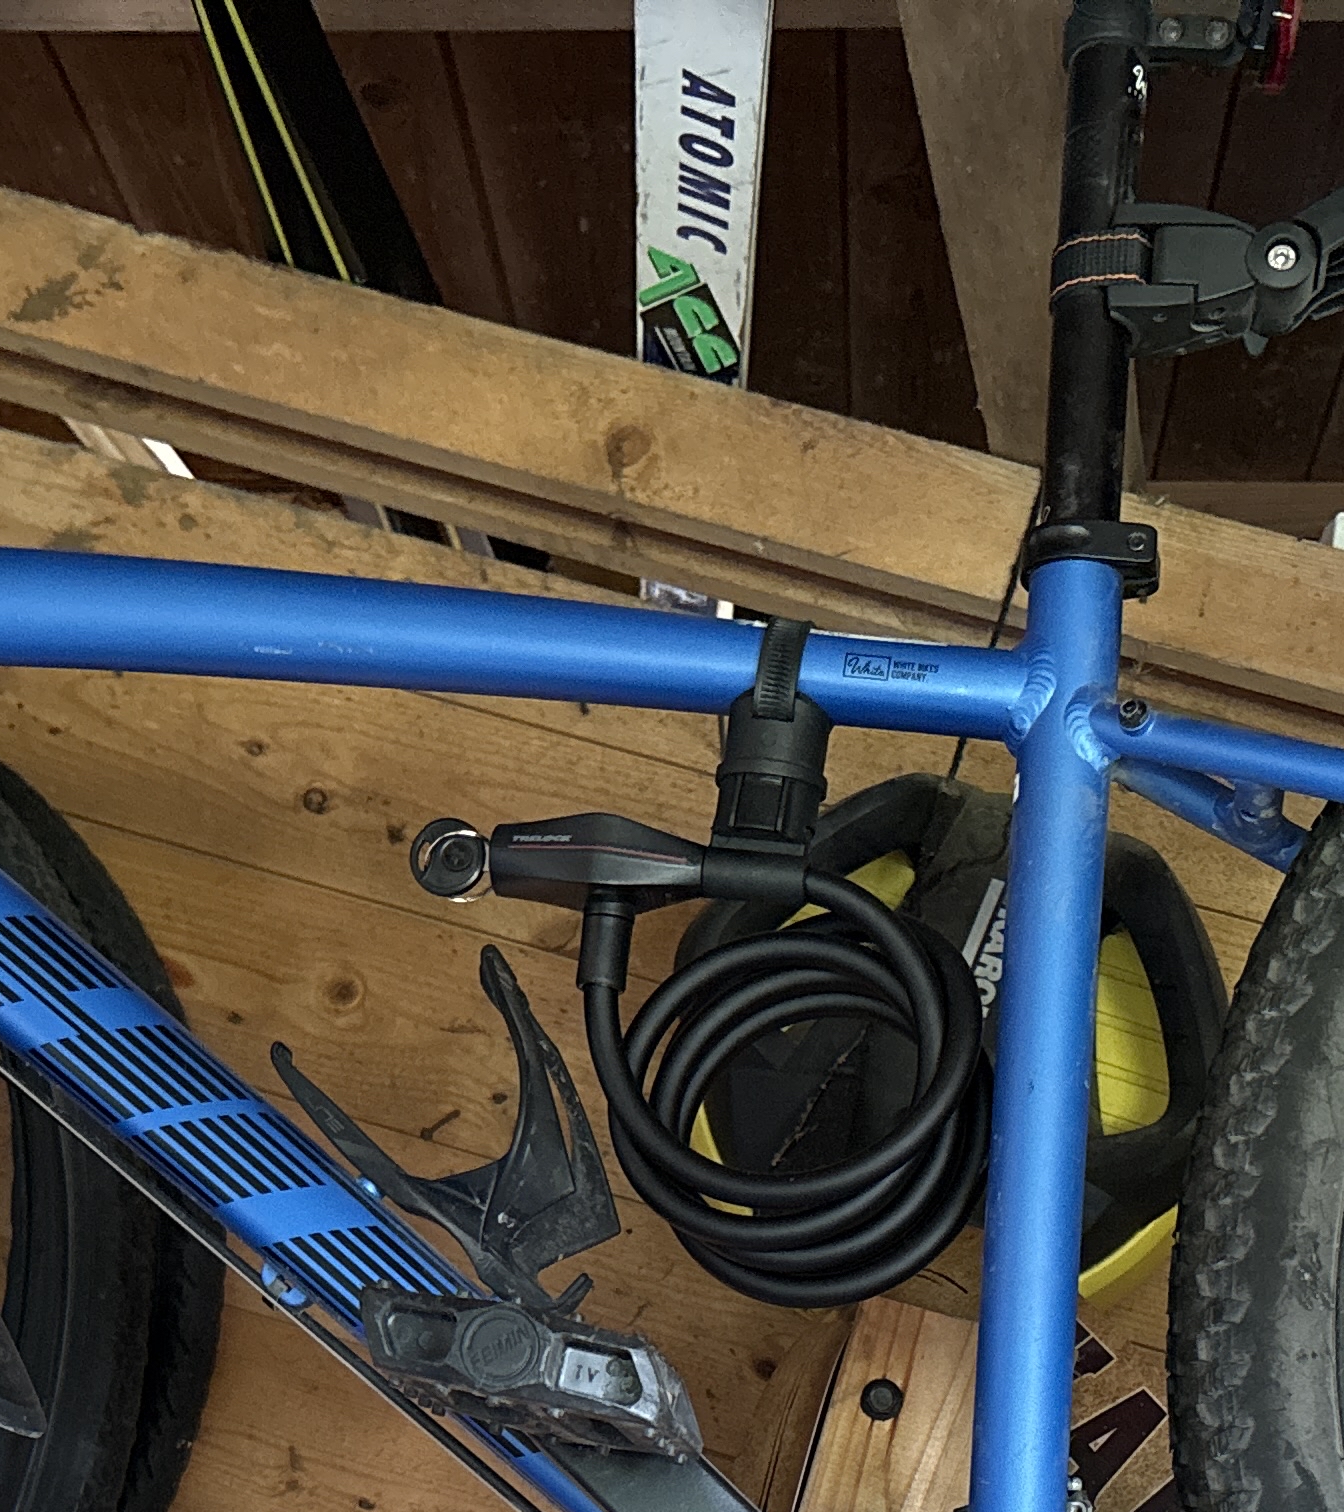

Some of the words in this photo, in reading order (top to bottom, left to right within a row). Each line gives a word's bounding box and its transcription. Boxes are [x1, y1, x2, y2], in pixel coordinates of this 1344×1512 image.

[676, 68, 737, 255] ATOMIC
[847, 656, 885, 677] White
[893, 660, 916, 671] WHITE
